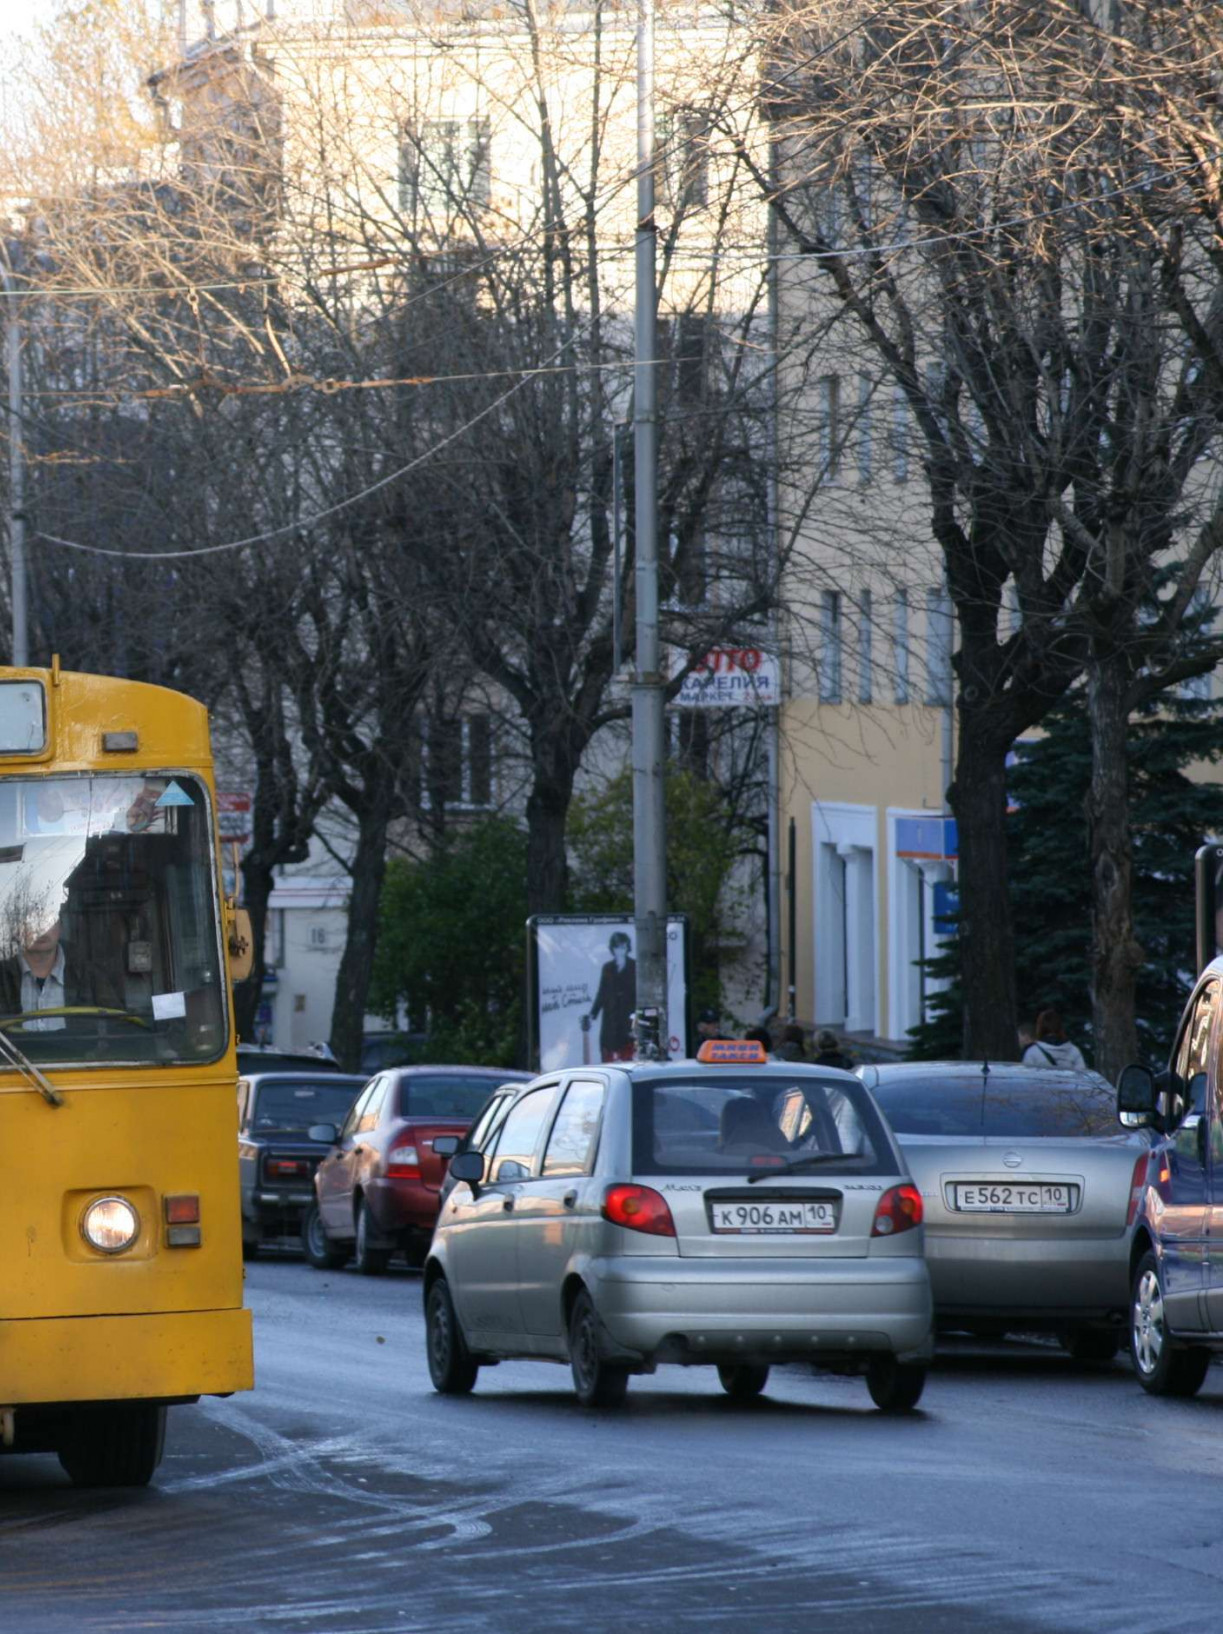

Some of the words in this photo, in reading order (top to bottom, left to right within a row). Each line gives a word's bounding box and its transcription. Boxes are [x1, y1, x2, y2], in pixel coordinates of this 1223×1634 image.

[681, 675, 769, 689] КАРЕЛИЯ
[1046, 1188, 1062, 1201] 10
[808, 1205, 826, 1220] 10
